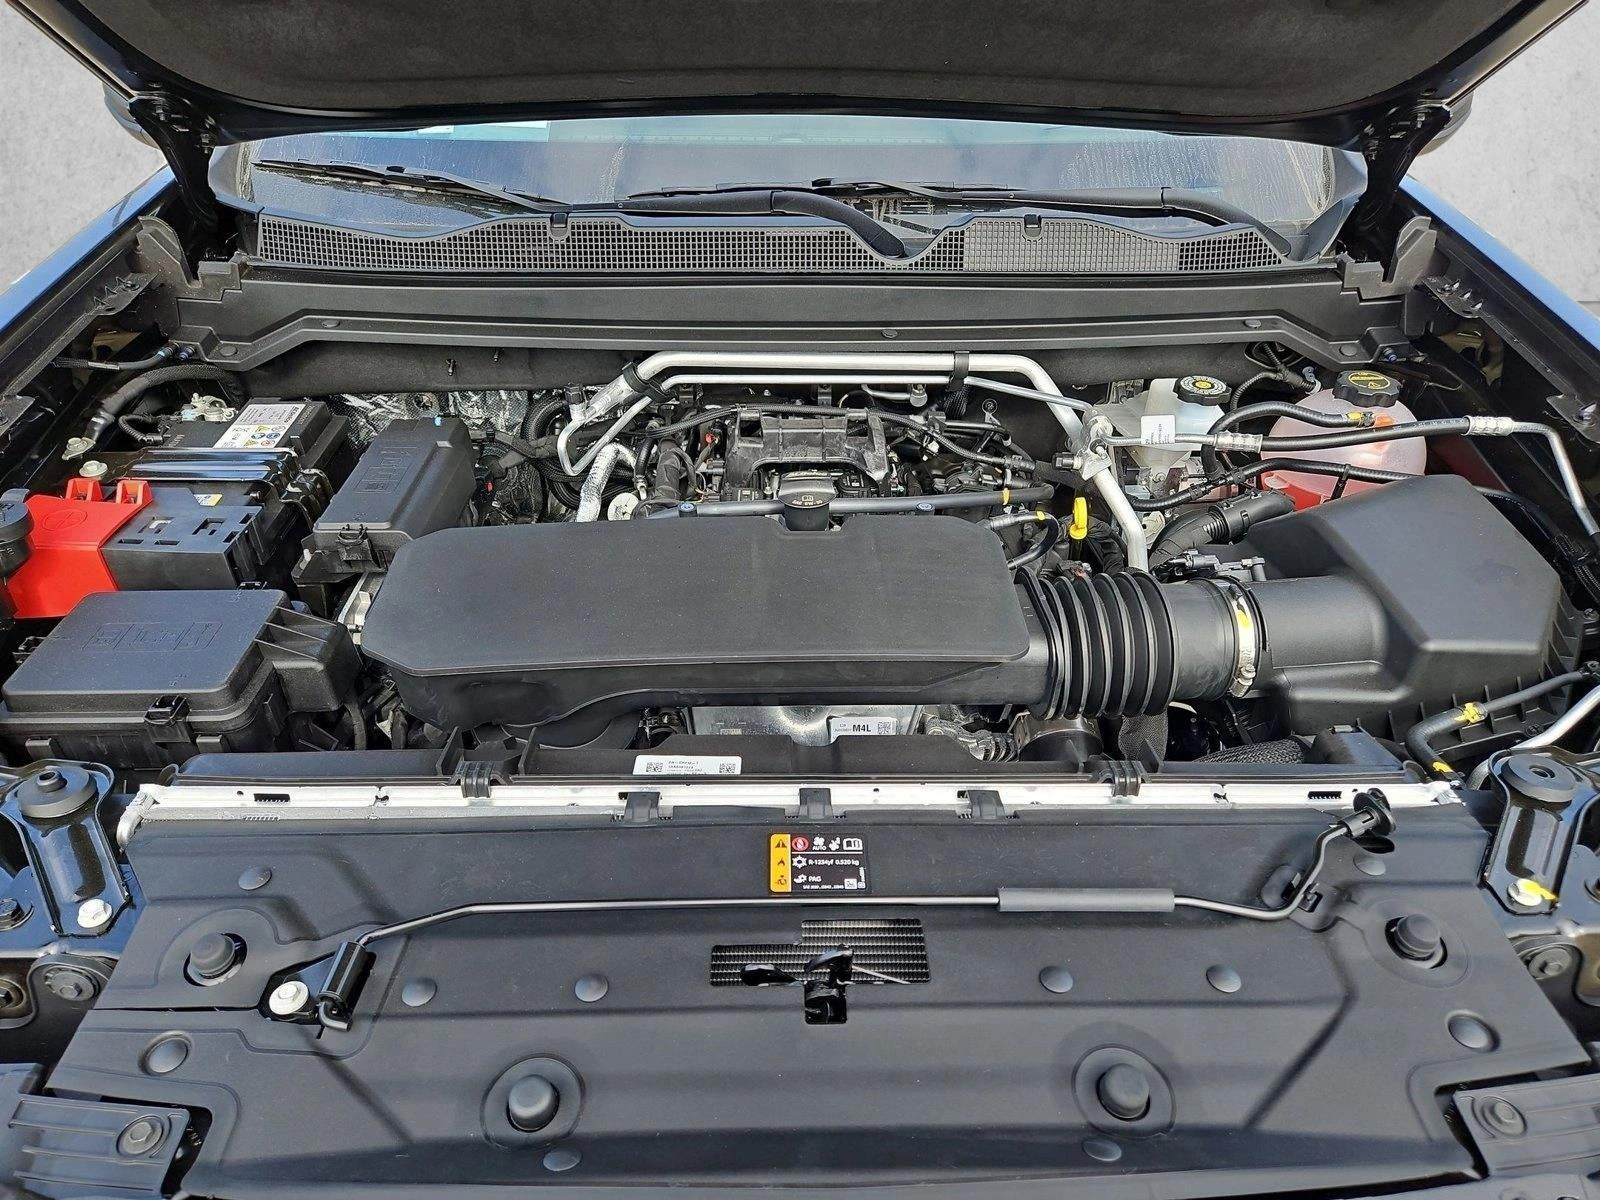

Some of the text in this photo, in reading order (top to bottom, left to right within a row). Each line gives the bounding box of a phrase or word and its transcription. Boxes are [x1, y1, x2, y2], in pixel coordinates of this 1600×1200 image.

[852, 724, 871, 732] M4L
[808, 858, 833, 866] R-1234yf
[852, 858, 859, 866] kg
